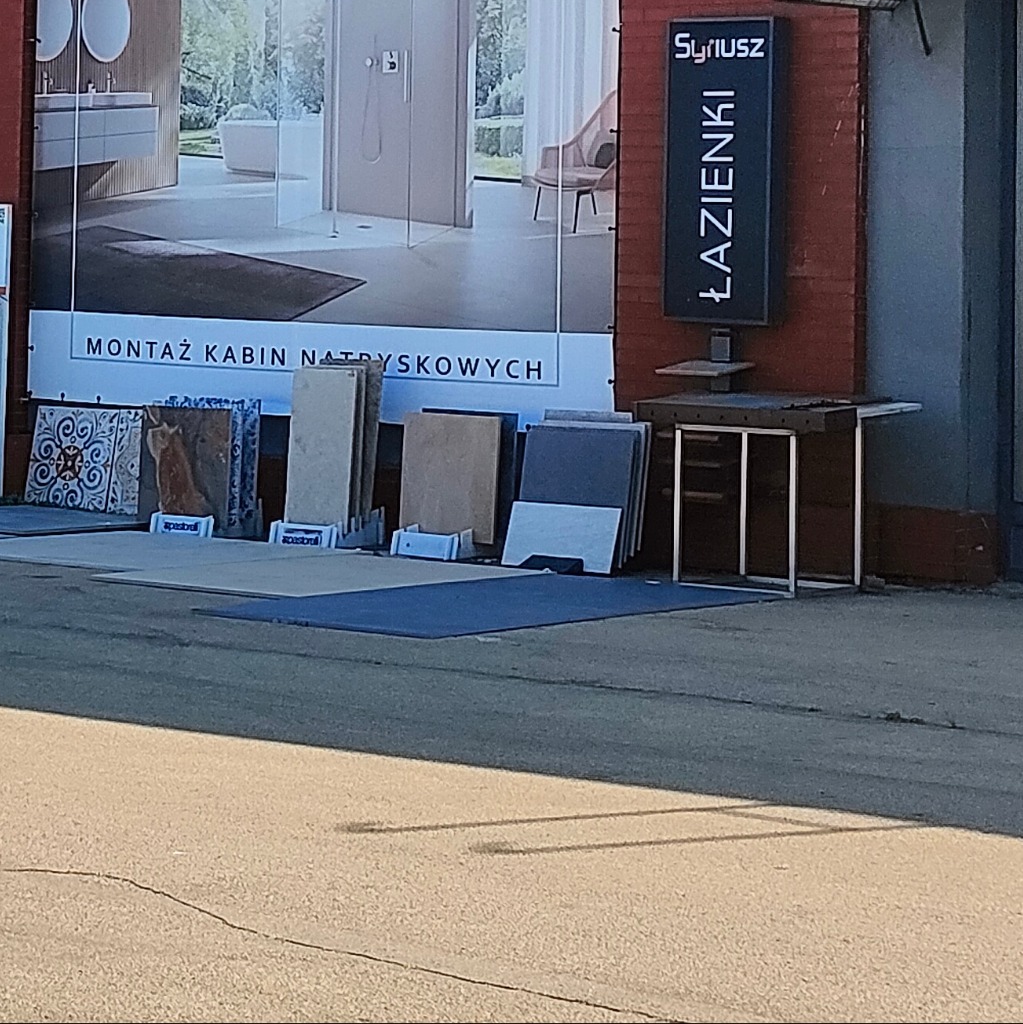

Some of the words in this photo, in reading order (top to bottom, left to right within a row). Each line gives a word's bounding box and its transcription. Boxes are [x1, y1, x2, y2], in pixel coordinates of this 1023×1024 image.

[699, 90, 735, 303] ŁAZIENKI
[86, 337, 193, 361] MONTAŻ
[205, 344, 287, 366] KABIN
